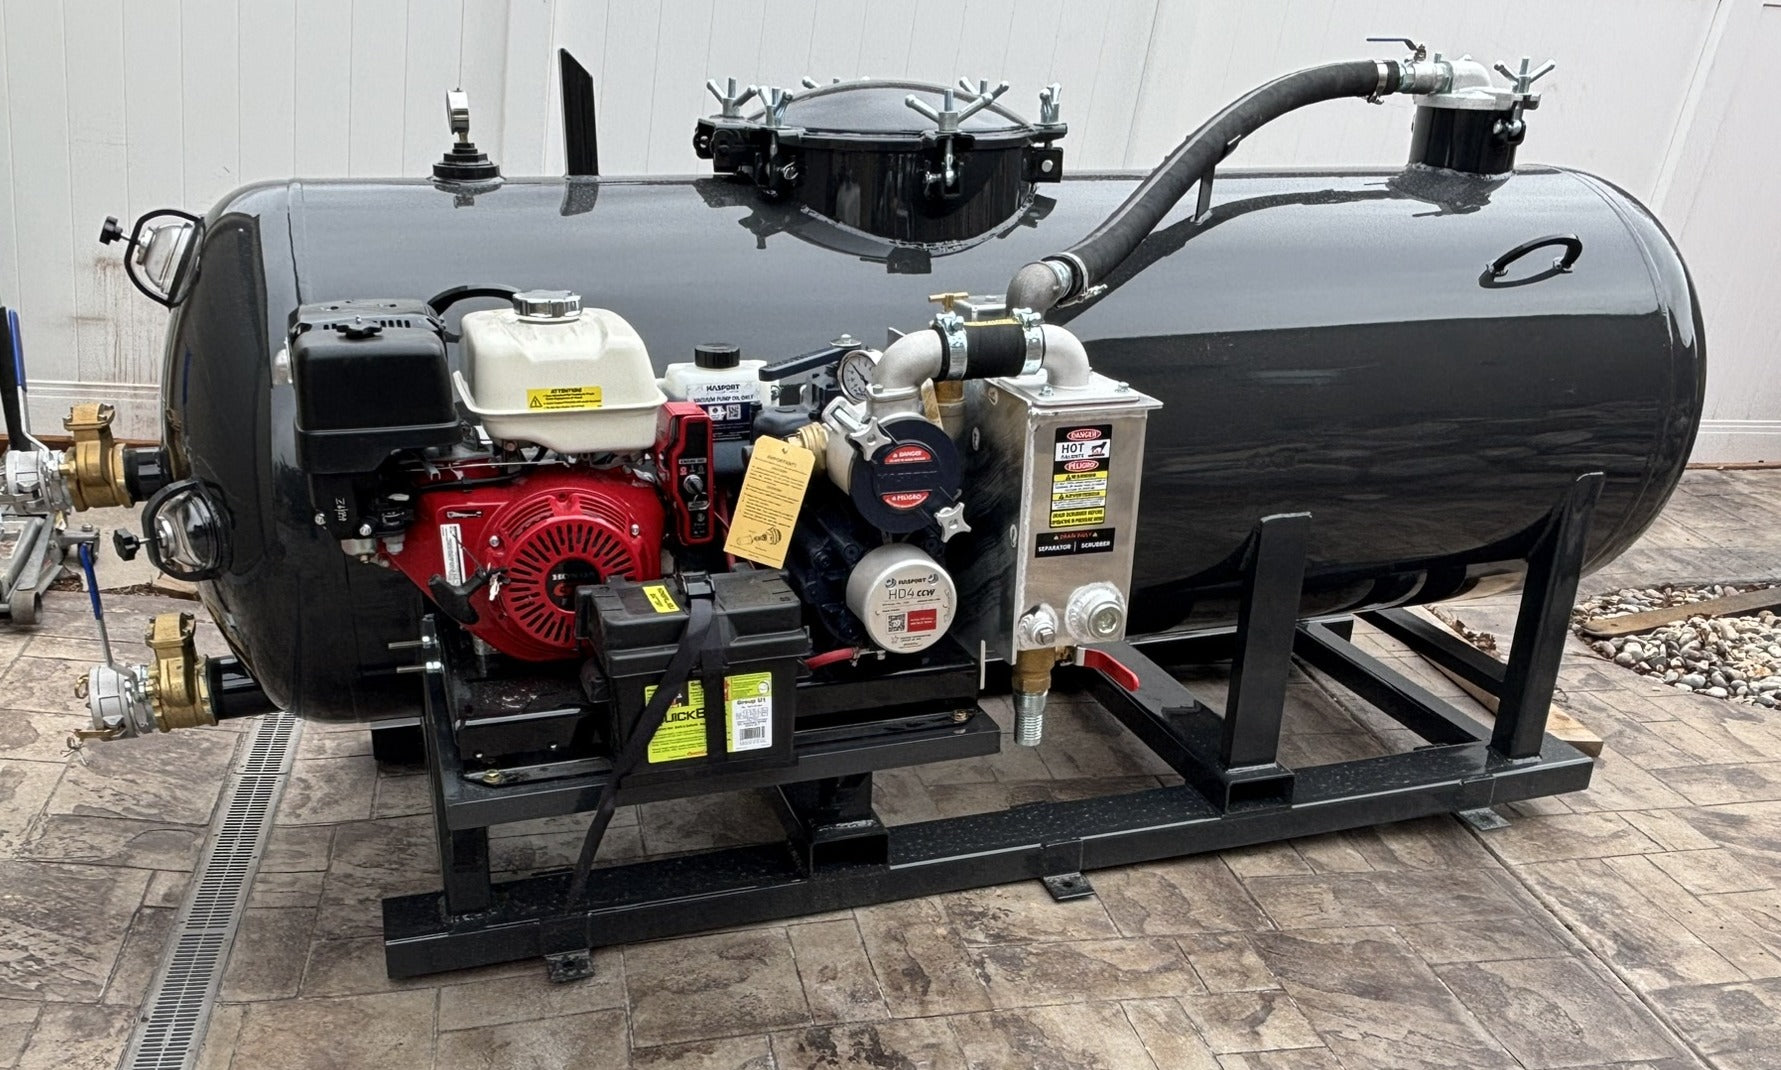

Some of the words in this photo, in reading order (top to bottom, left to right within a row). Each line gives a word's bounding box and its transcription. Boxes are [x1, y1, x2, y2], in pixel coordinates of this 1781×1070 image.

[1070, 430, 1097, 439] DANGER
[1061, 443, 1085, 454] HOT
[897, 493, 922, 501] PELIGRO
[1038, 543, 1072, 552] SEPARATOR
[1081, 540, 1111, 549] SCRUBBER
[888, 588, 915, 600] HD4
[916, 588, 936, 597] CCW
[664, 707, 705, 723] UICKE
